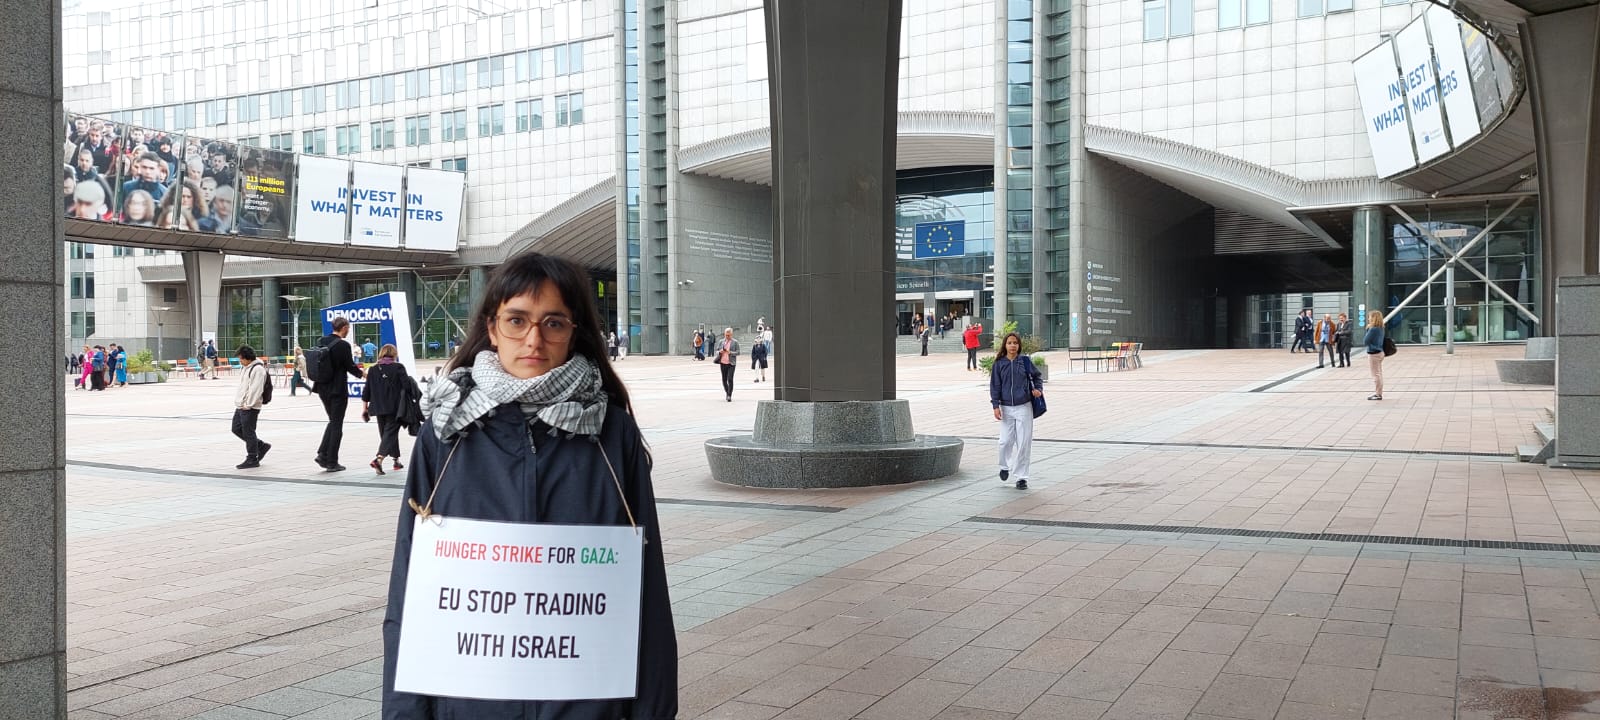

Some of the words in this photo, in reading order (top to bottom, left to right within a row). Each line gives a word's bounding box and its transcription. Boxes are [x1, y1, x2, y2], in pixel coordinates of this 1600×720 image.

[1387, 63, 1426, 101] INVEST
[1372, 103, 1405, 133] WHAT
[1411, 69, 1459, 115] MATTERS
[245, 182, 286, 194] Europeans
[259, 177, 285, 186] million
[337, 186, 397, 203] INVEST
[407, 193, 423, 206] IN
[310, 199, 363, 216] WHAT
[369, 205, 444, 222] MATTERS
[326, 307, 395, 322] DEMOCRACY
[435, 540, 487, 560] HUNGER
[492, 545, 544, 564] STRIKE
[548, 547, 576, 564] FOR
[581, 547, 619, 564] GAZA:
[438, 587, 461, 611] EU
[467, 589, 517, 614] STOP
[524, 593, 607, 616] TRADING
[457, 632, 505, 658] WITH
[511, 635, 580, 659] ISRAEL
